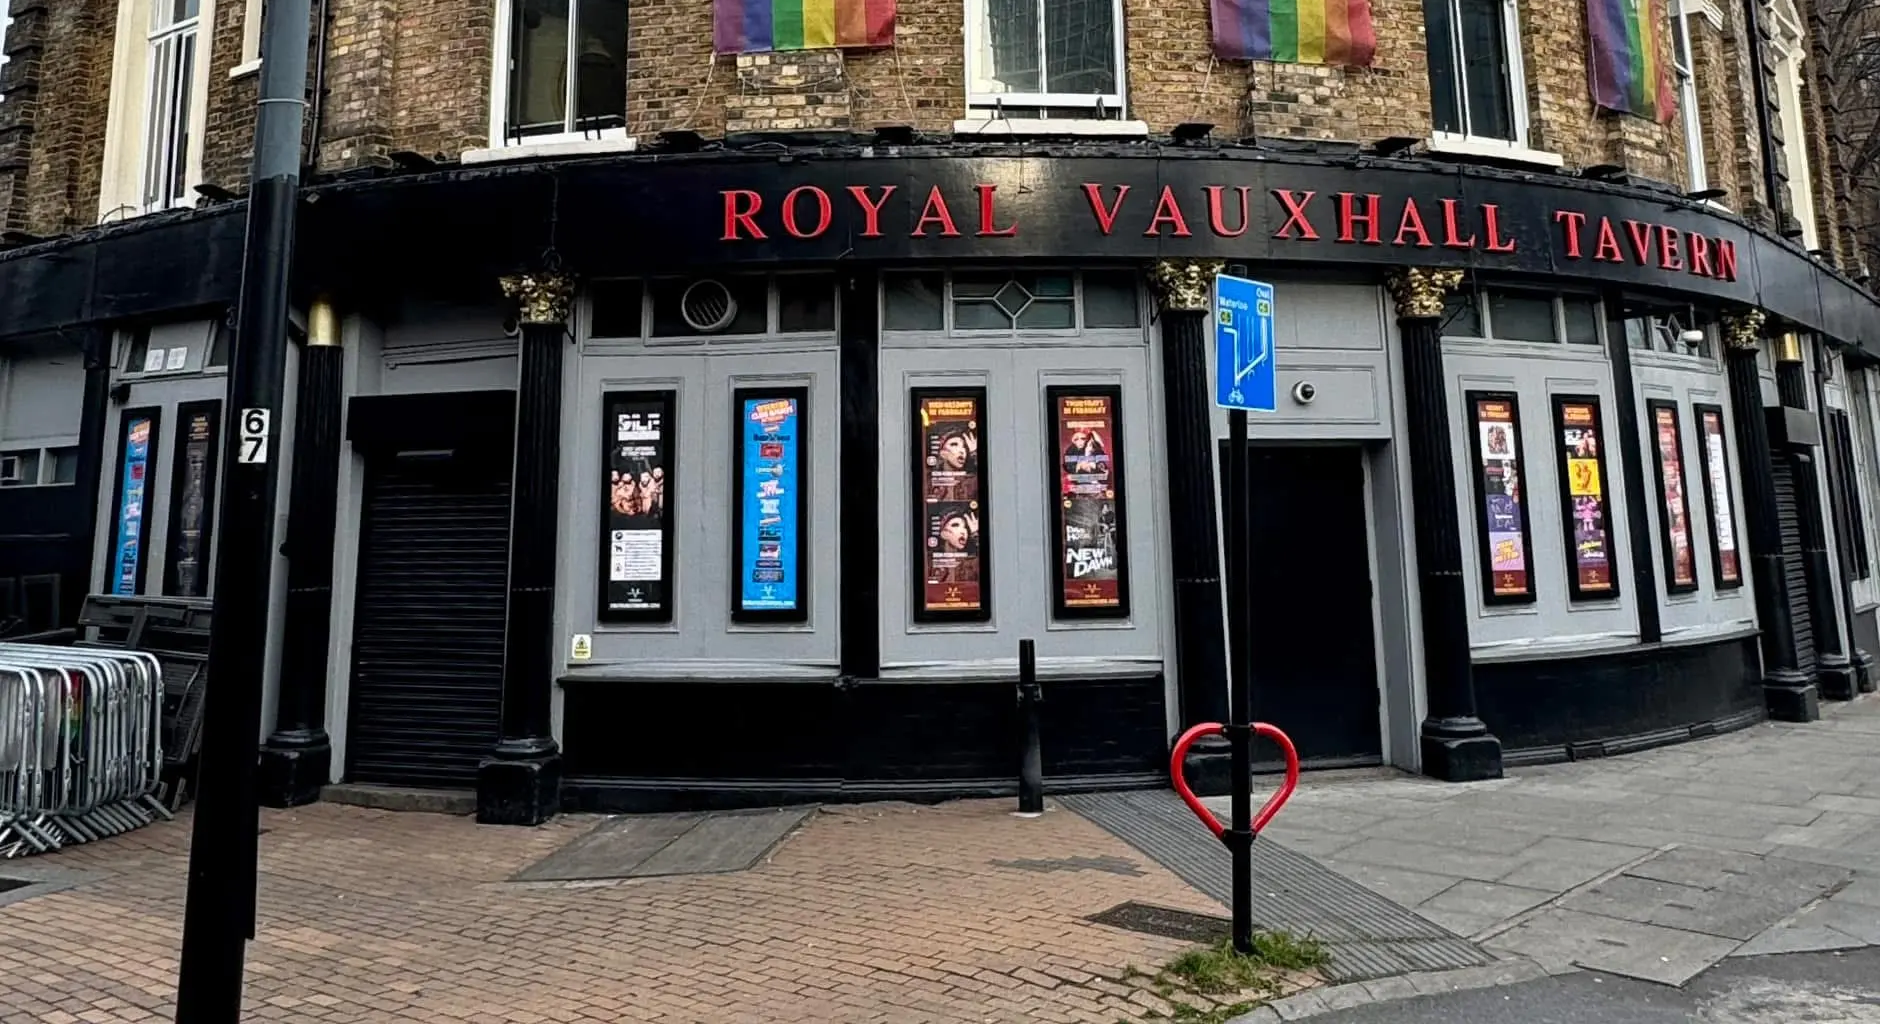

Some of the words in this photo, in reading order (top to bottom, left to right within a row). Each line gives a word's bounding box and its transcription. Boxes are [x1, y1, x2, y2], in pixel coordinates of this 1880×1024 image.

[719, 183, 1018, 242] ROYAL
[1082, 182, 1515, 253] VAUXHALL
[1552, 209, 1738, 282] TAVERN
[1066, 547, 1105, 564] NEW
[1073, 556, 1113, 578] DAWN
